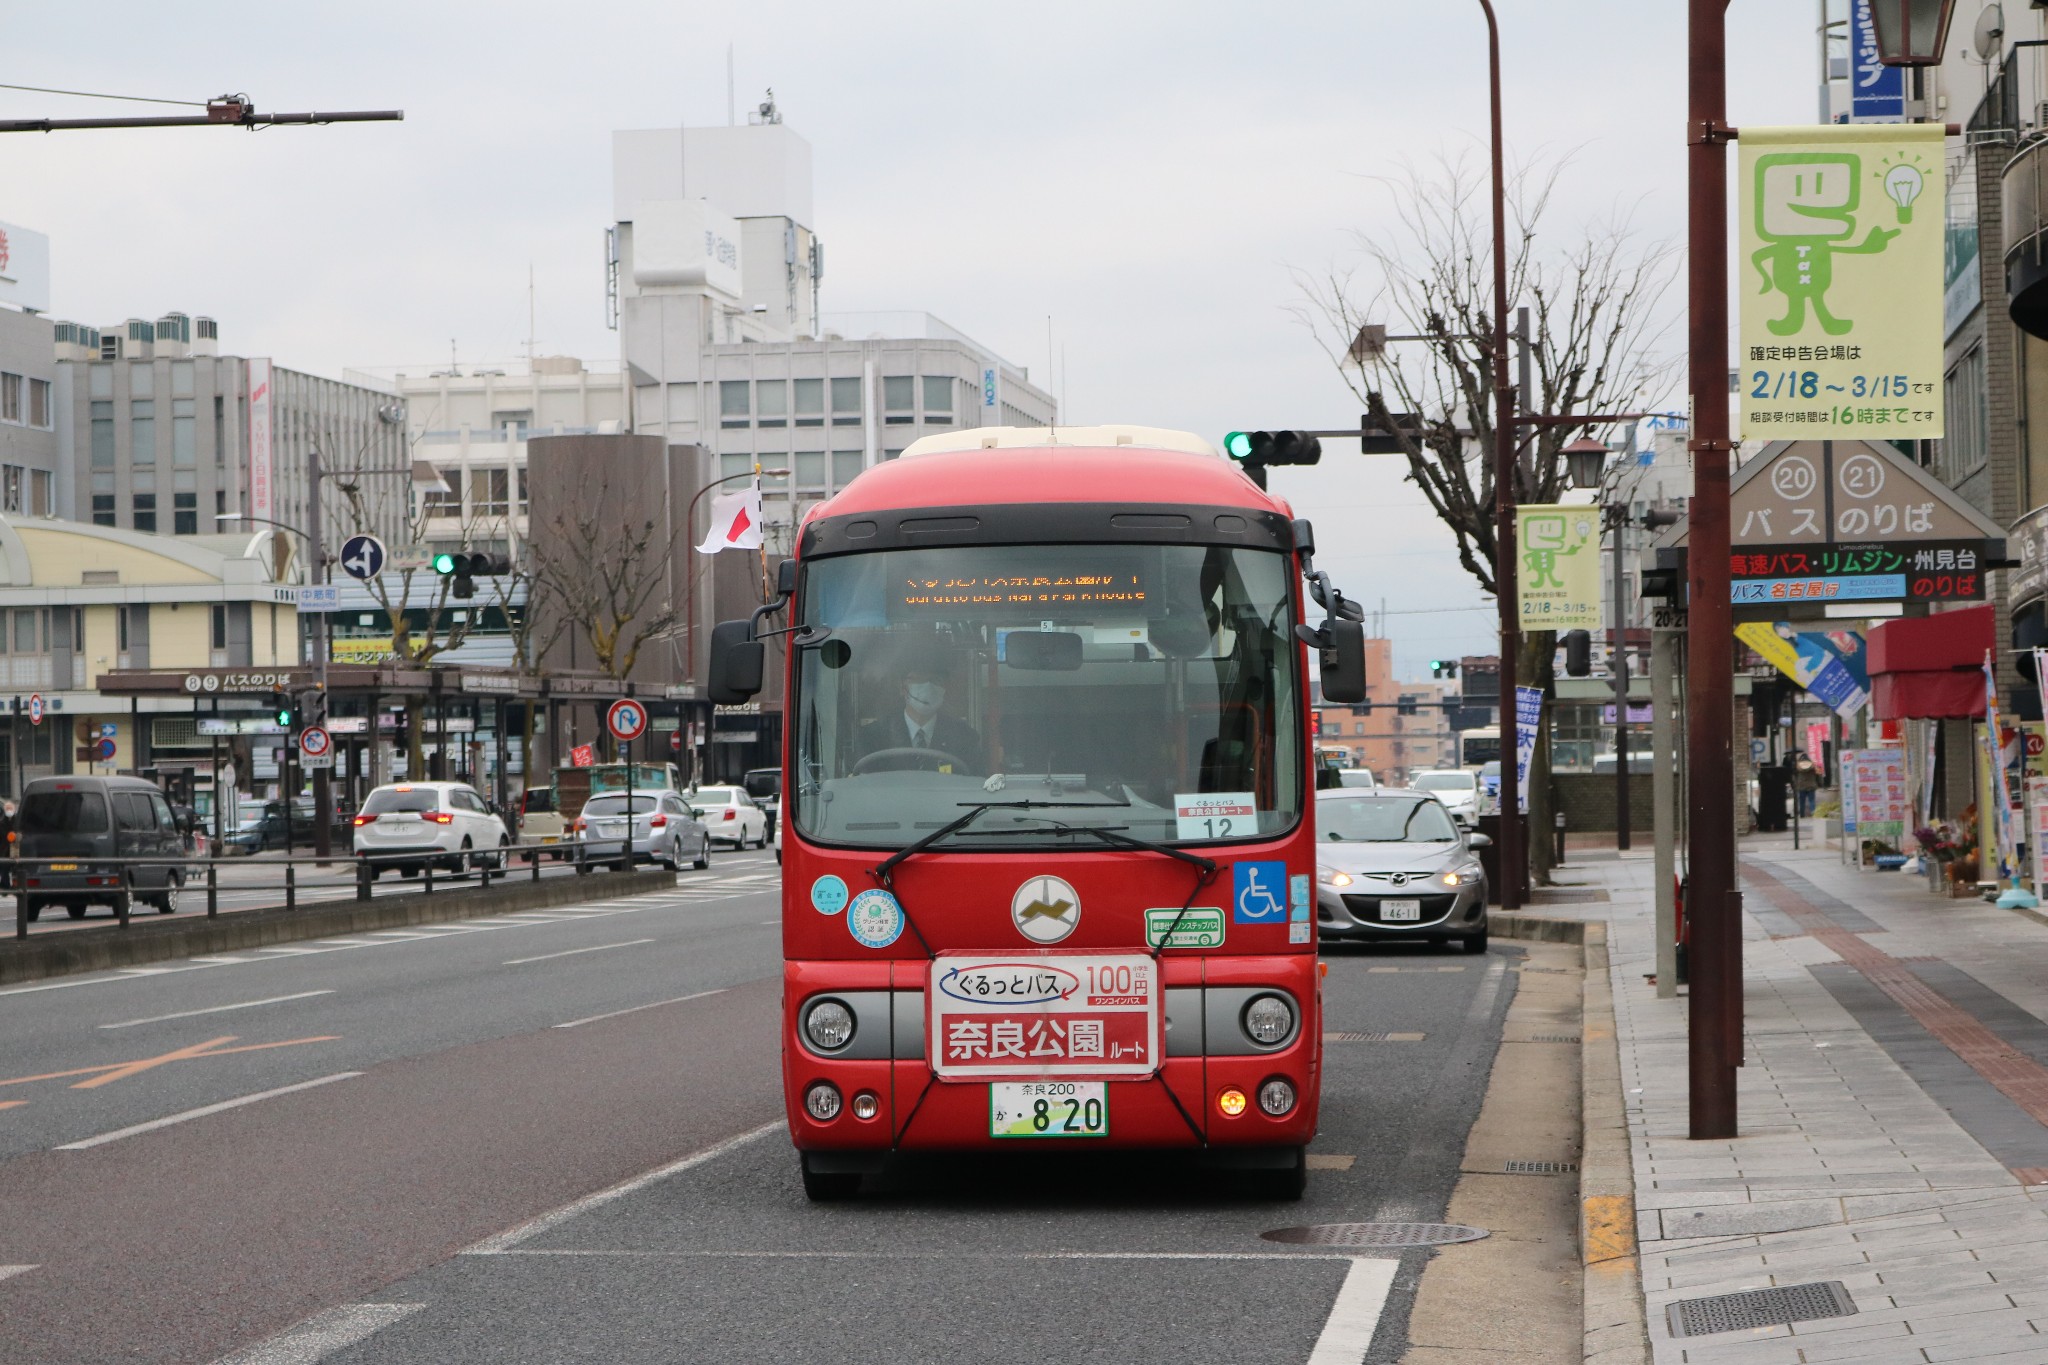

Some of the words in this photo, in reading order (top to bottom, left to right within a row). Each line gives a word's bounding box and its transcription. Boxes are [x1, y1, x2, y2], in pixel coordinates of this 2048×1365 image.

[1750, 346, 1861, 361] 確定申告会場は
[985, 369, 994, 406] SECOM
[1740, 502, 1935, 537] バスのりば
[302, 589, 336, 600] 中筋町
[1731, 584, 1765, 600] バス
[1914, 575, 1976, 597] のりば
[223, 674, 291, 685] バスのりば
[1752, 741, 1765, 760] P
[1188, 807, 1243, 816] 奈良公園ルート
[1203, 818, 1232, 838] 12
[959, 973, 1060, 996] ぐるっとバス
[1087, 966, 1131, 994] 100
[1095, 997, 1141, 1005] ワンコインバス
[949, 1020, 1105, 1060] 奈良公園
[1110, 1041, 1145, 1059] ルート
